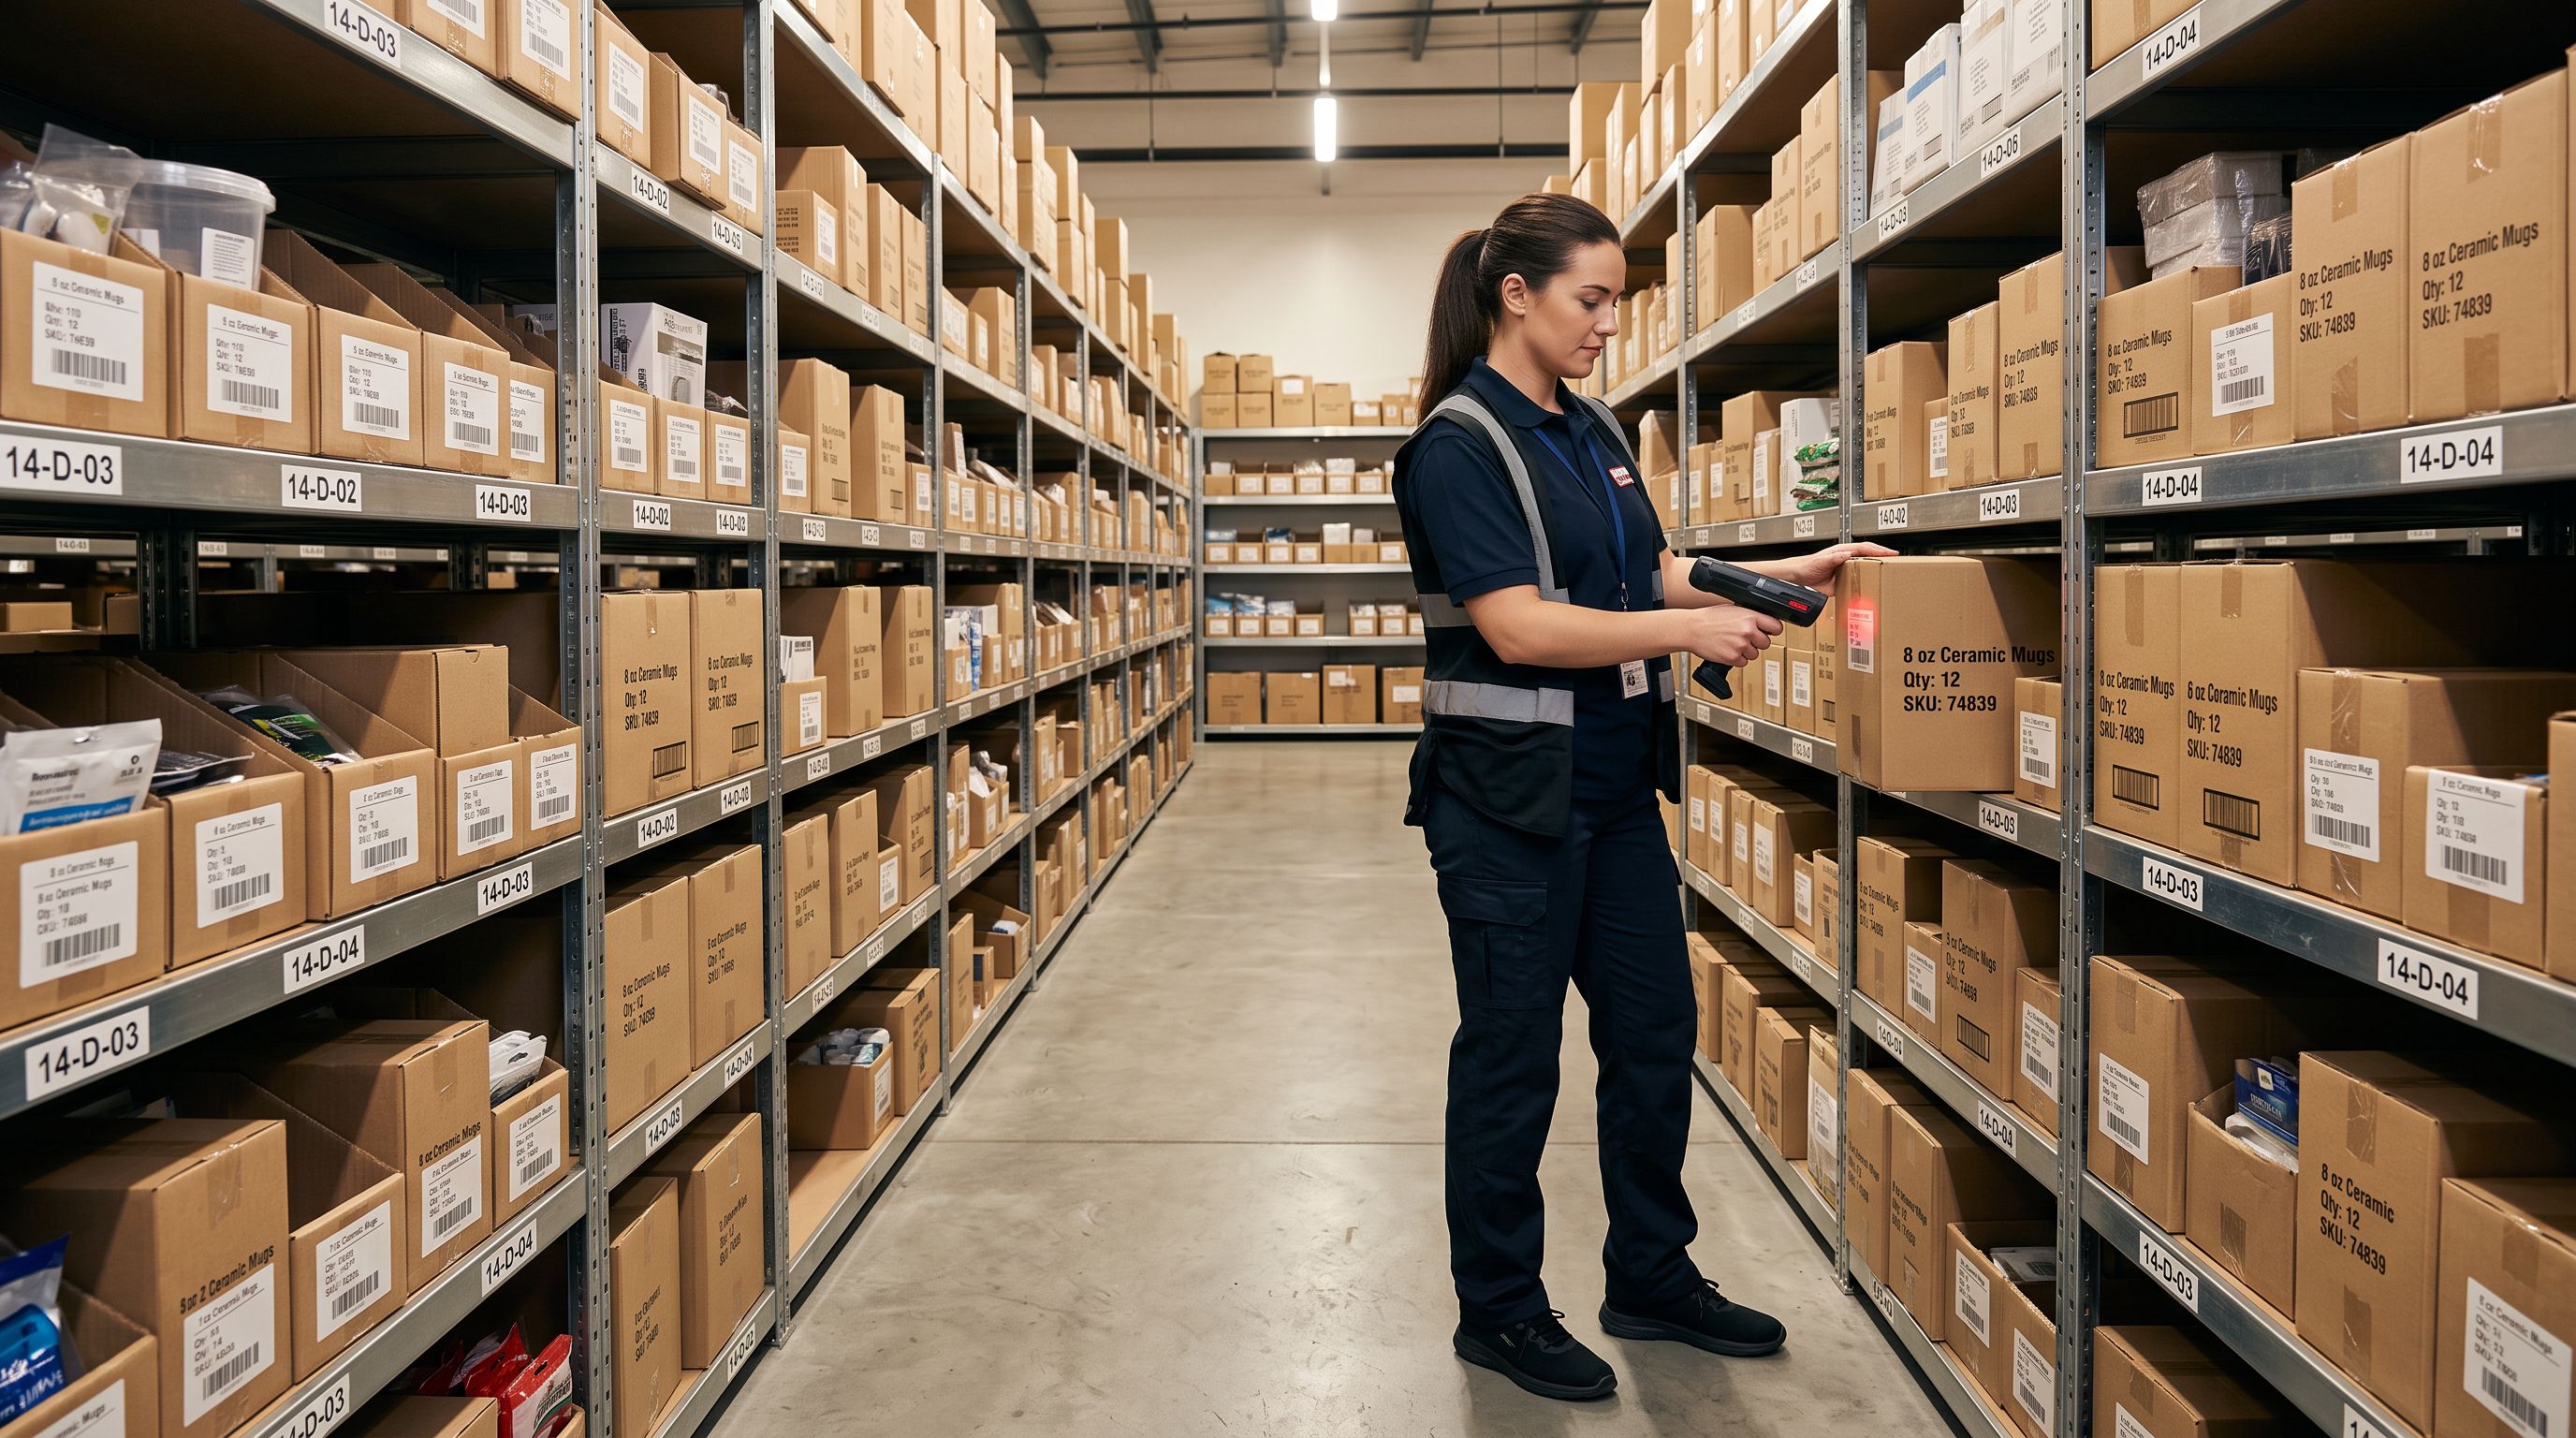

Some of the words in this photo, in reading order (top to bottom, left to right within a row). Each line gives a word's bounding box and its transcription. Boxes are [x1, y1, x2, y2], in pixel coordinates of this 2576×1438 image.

[330, 1, 396, 58] 14-D-03
[2145, 20, 2197, 70] 14-D-04
[2422, 253, 2429, 271] 8
[2433, 253, 2445, 269] oz
[2449, 231, 2497, 264] Ceramic
[2502, 223, 2539, 248] Mugs
[2300, 272, 2305, 290] 8
[2307, 272, 2318, 287] oz
[2320, 256, 2360, 285] Ceramic
[2364, 249, 2393, 271] Mugs
[2449, 271, 2464, 290] 12
[2320, 291, 2332, 310] 12
[2422, 306, 2450, 330] SKU:
[2453, 293, 2492, 322] 74839
[2300, 322, 2321, 343] SKU:
[2323, 312, 2355, 337] 74839
[2041, 339, 2058, 357] Mugs
[2108, 344, 2112, 358] 8
[2123, 333, 2149, 354] Ceramic
[2151, 330, 2172, 346] Mugs
[2123, 358, 2132, 373] 12
[7, 447, 113, 484] 14-D-03
[2408, 436, 2494, 474] 14-D-04
[288, 474, 357, 504] 14-D-02
[2145, 473, 2198, 499] 14-D-04
[480, 492, 527, 516] 14-D-03
[1982, 493, 2017, 516] 14-D-03
[709, 657, 711, 670] 8
[1904, 648, 1913, 664] 8
[1918, 650, 1936, 664] oz
[1940, 646, 2006, 664] Ceramic
[2012, 647, 2056, 666] Mugs
[624, 668, 629, 683] 8
[663, 664, 678, 681] Mugs
[721, 676, 726, 689] 12
[1904, 672, 1936, 689] Qty:
[1941, 672, 1960, 687] 12
[2100, 670, 2104, 686] 8
[2106, 673, 2115, 687] oz
[2116, 670, 2149, 693] Ceramic
[2150, 676, 2174, 700] Mugs
[638, 689, 647, 704] 12
[1904, 696, 1941, 712] SKU:
[1947, 696, 1997, 712] 74839
[2116, 698, 2127, 716] 12
[2194, 685, 2205, 701] oz
[2248, 687, 2277, 715] Mugs
[2119, 725, 2144, 745] 74839
[2208, 713, 2220, 734] 12
[2187, 738, 2209, 761] SKU:
[2211, 743, 2242, 768] 74839
[641, 814, 676, 841] 14-D-02
[483, 870, 529, 906] 14-D-03
[2147, 865, 2198, 902] 14-D-03
[292, 935, 359, 981] 14-D-04
[1958, 960, 1965, 976] 12
[2387, 951, 2468, 1005] 14-D-04
[39, 1020, 139, 1083] 14-D-03
[462, 1122, 481, 1141] Mugs
[2321, 1163, 2328, 1181] 8
[2331, 1172, 2343, 1192] oz
[2346, 1178, 2394, 1225] Ceramic
[2321, 1189, 2342, 1219] Qty:
[2346, 1206, 2360, 1231] 12
[486, 1229, 534, 1289] 14-D-04
[2320, 1215, 2346, 1249] SKU:
[2349, 1234, 2385, 1276] 74839
[209, 1262, 247, 1297] Ceramic
[249, 1245, 273, 1271] Mugs
[2144, 1242, 2192, 1301] 14-D-03
[281, 1387, 345, 1437] 4-D-03
